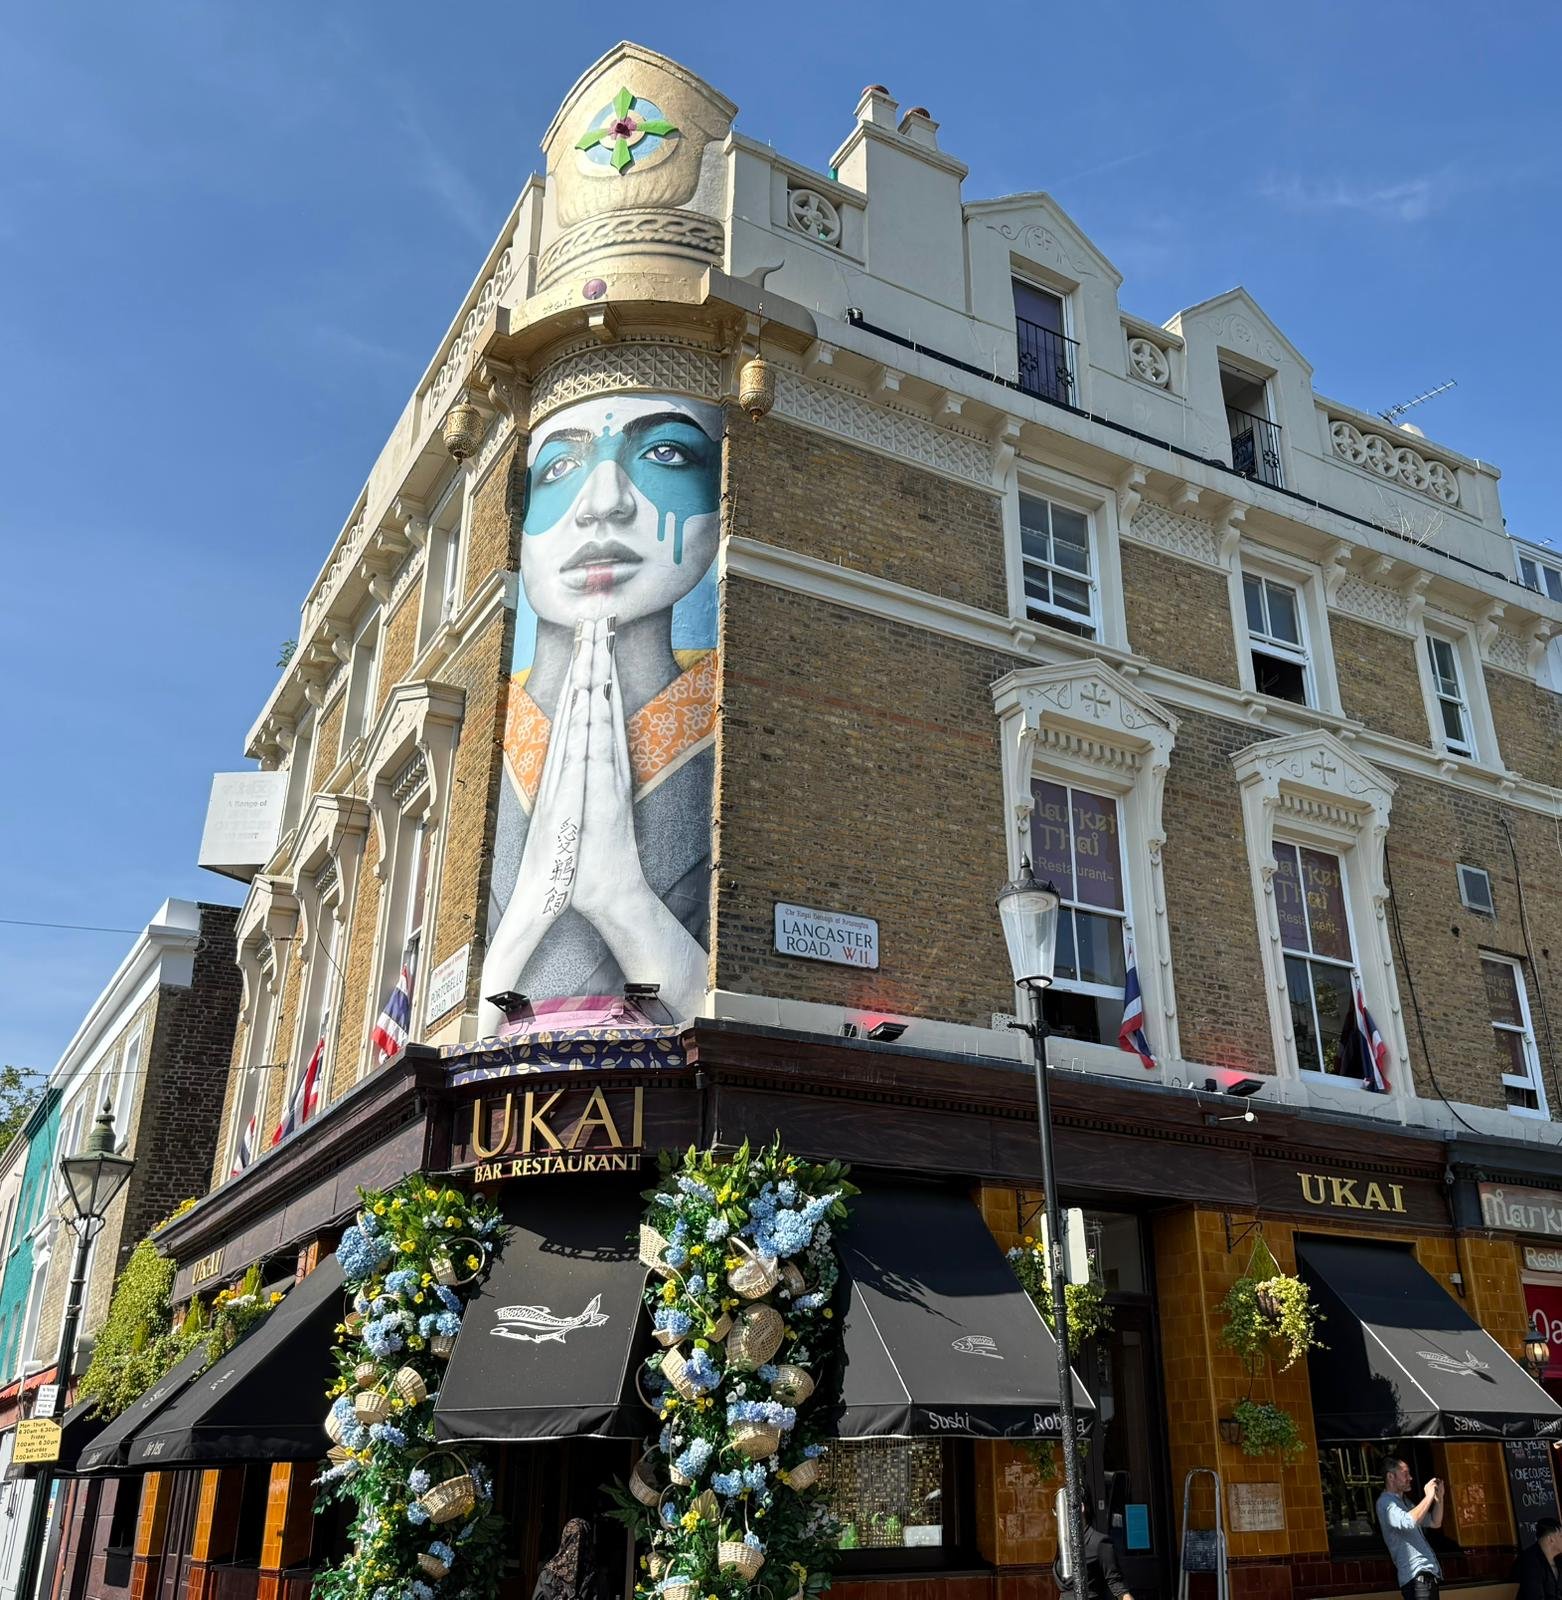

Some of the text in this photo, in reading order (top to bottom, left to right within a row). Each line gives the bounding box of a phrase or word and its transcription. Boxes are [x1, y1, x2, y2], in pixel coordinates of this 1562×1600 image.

[782, 919, 873, 950] LANCASTER
[472, 1085, 645, 1159] UKAI
[474, 1153, 641, 1184] BAR RESTAURANT
[1296, 1172, 1408, 1214] UKAI
[1481, 1188, 1562, 1234] Mark
[192, 1248, 223, 1286] UKAI
[928, 1411, 971, 1431] Sushi
[1453, 1416, 1481, 1432] Sake
